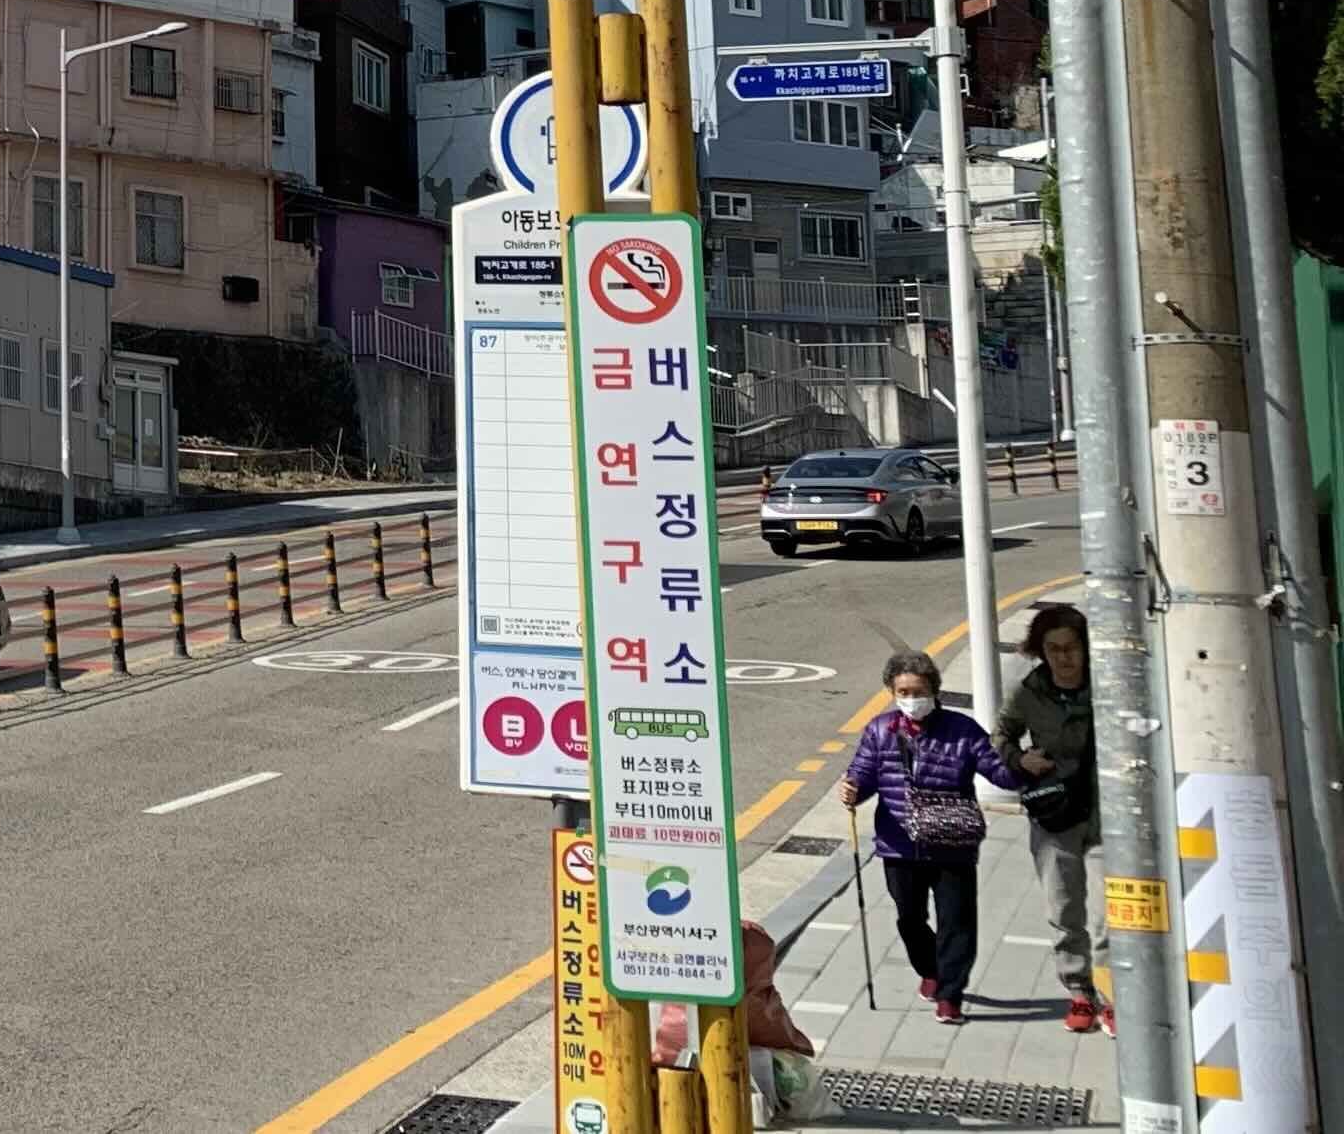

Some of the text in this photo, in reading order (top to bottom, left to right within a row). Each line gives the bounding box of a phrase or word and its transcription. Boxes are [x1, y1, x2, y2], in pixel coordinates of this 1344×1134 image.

[504, 240, 546, 250] Children
[479, 336, 497, 348] 87
[1187, 461, 1209, 485] 3
[592, 347, 648, 683] 금연구역
[648, 346, 707, 686] 버스정류소
[512, 681, 565, 691] ALWAYS
[502, 714, 525, 738] B
[648, 723, 673, 734] BUS
[621, 755, 702, 774] 버스정류소
[622, 779, 703, 797] 표지판으로
[615, 802, 713, 822] 부터10m이내
[624, 923, 718, 941] 부산광역시 서구
[562, 890, 584, 1037] 버스정류소
[563, 1042, 585, 1059] 10M
